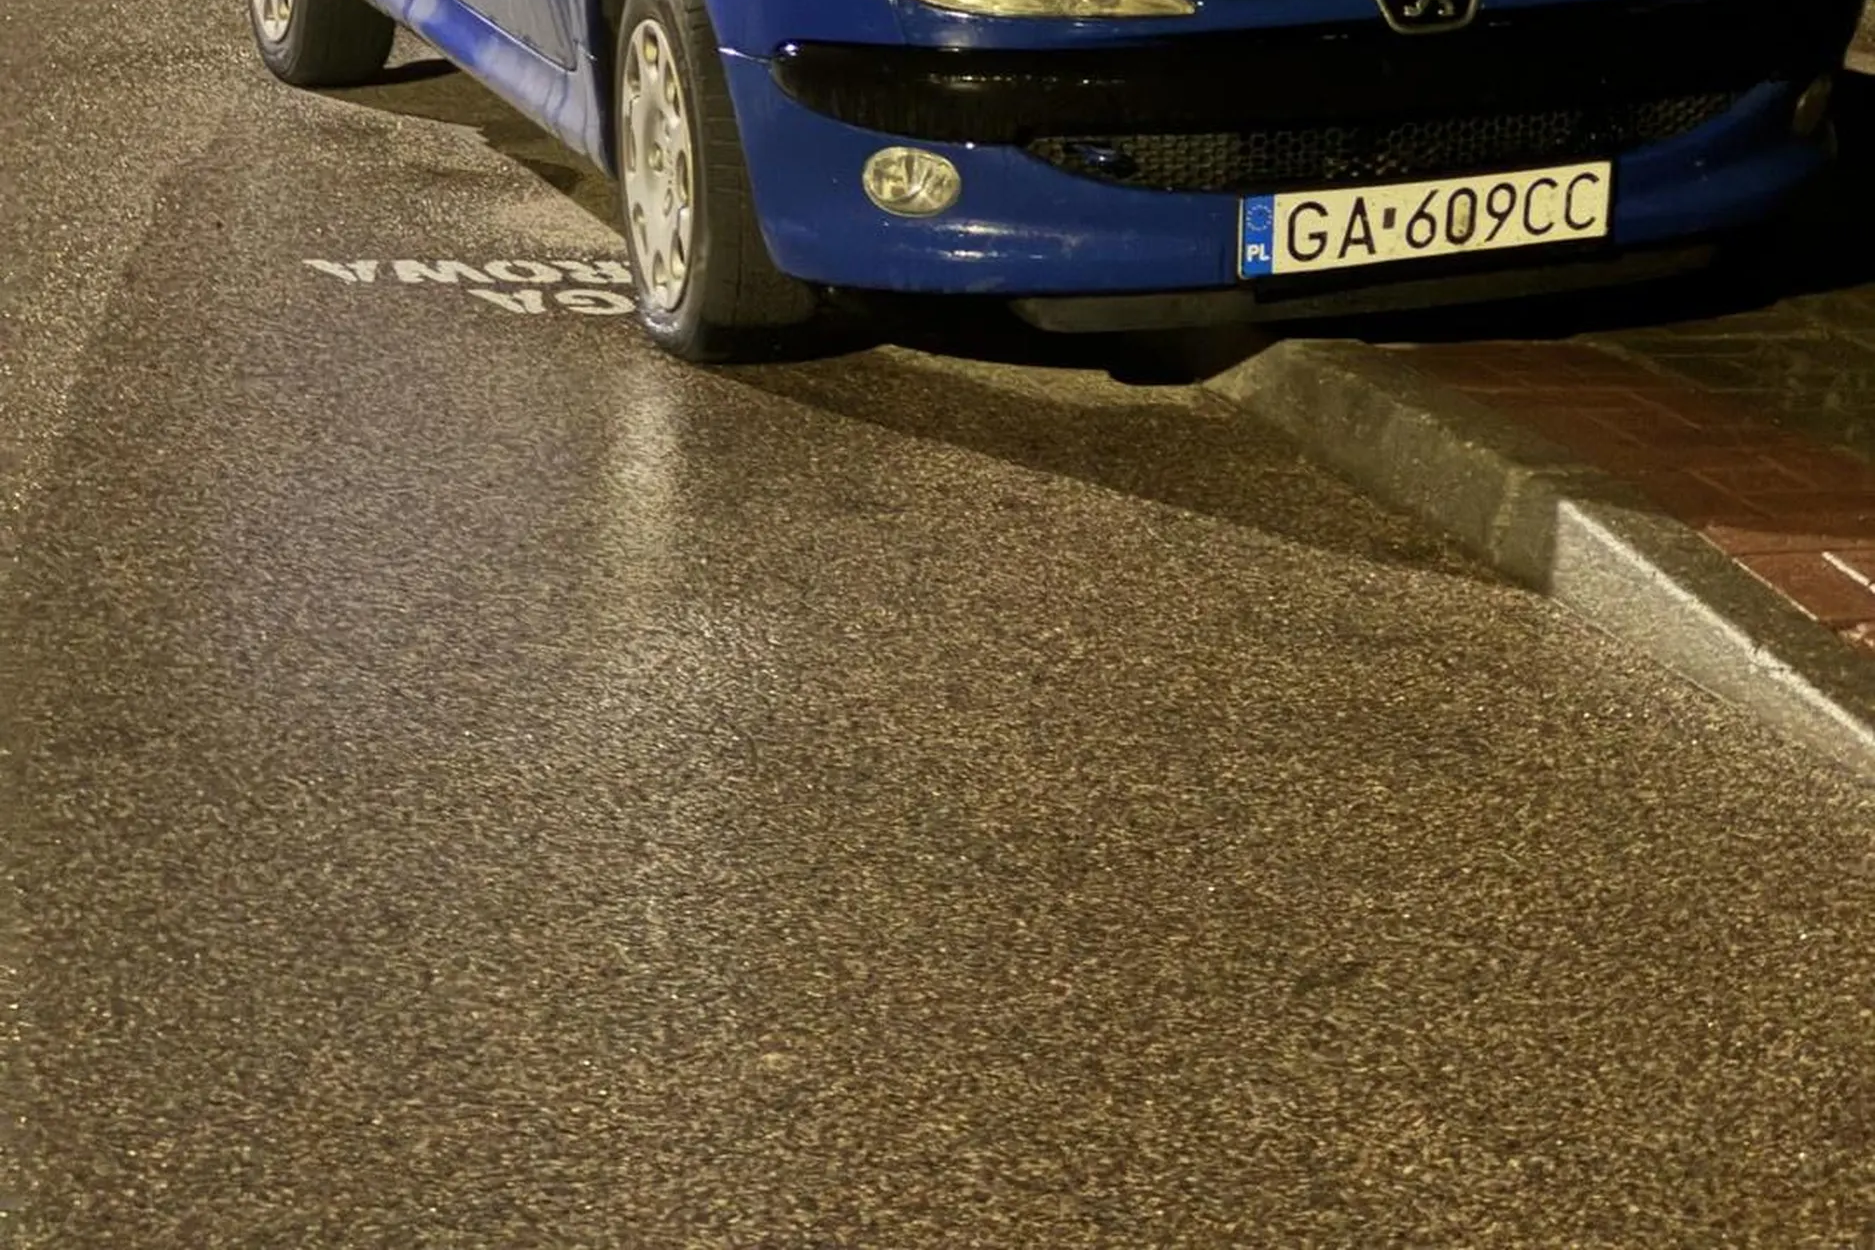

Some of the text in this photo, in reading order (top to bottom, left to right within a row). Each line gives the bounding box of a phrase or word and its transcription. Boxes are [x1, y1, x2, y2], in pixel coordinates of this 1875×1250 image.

[1286, 171, 1600, 262] GA 609CC
[1246, 244, 1271, 262] PL
